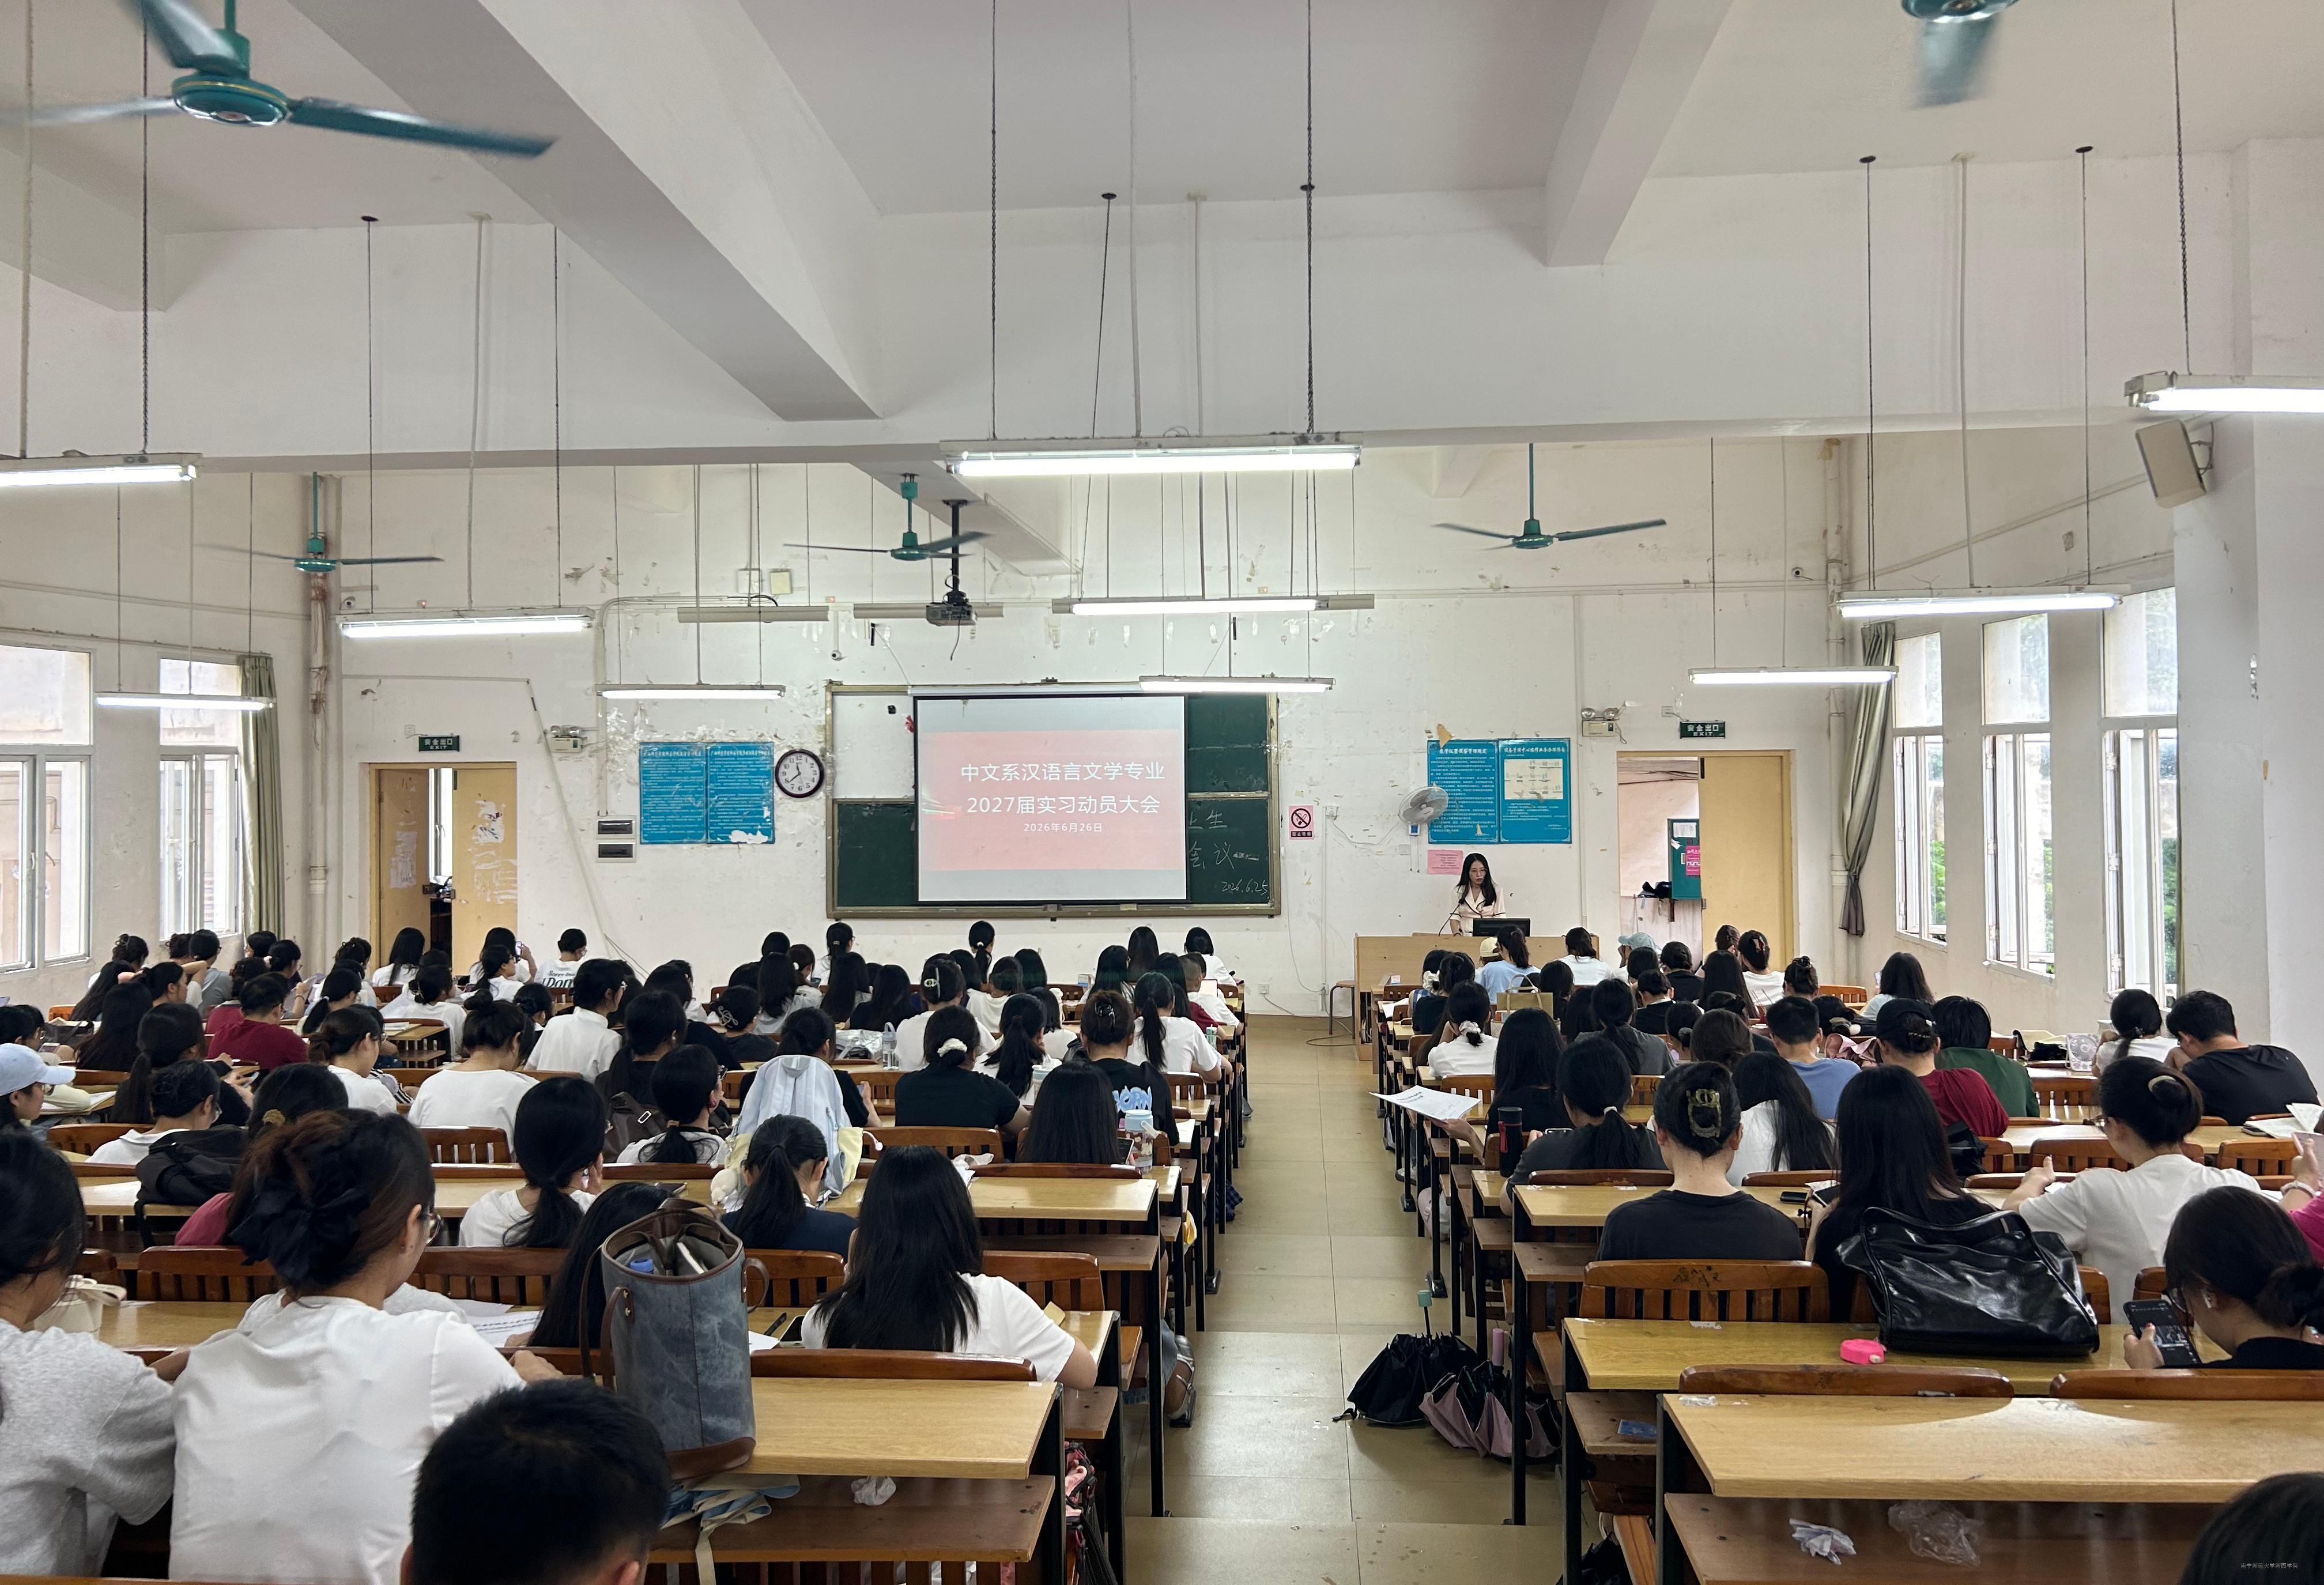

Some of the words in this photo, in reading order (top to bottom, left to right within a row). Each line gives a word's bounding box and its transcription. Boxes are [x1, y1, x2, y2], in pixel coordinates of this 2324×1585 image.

[961, 761, 1166, 782] 中文系汉语言文学专业
[967, 794, 1161, 814] 2027届实习动员大会
[1023, 822, 1103, 833] 2026年6月26日
[1221, 878, 1269, 896] 2026.6.25
